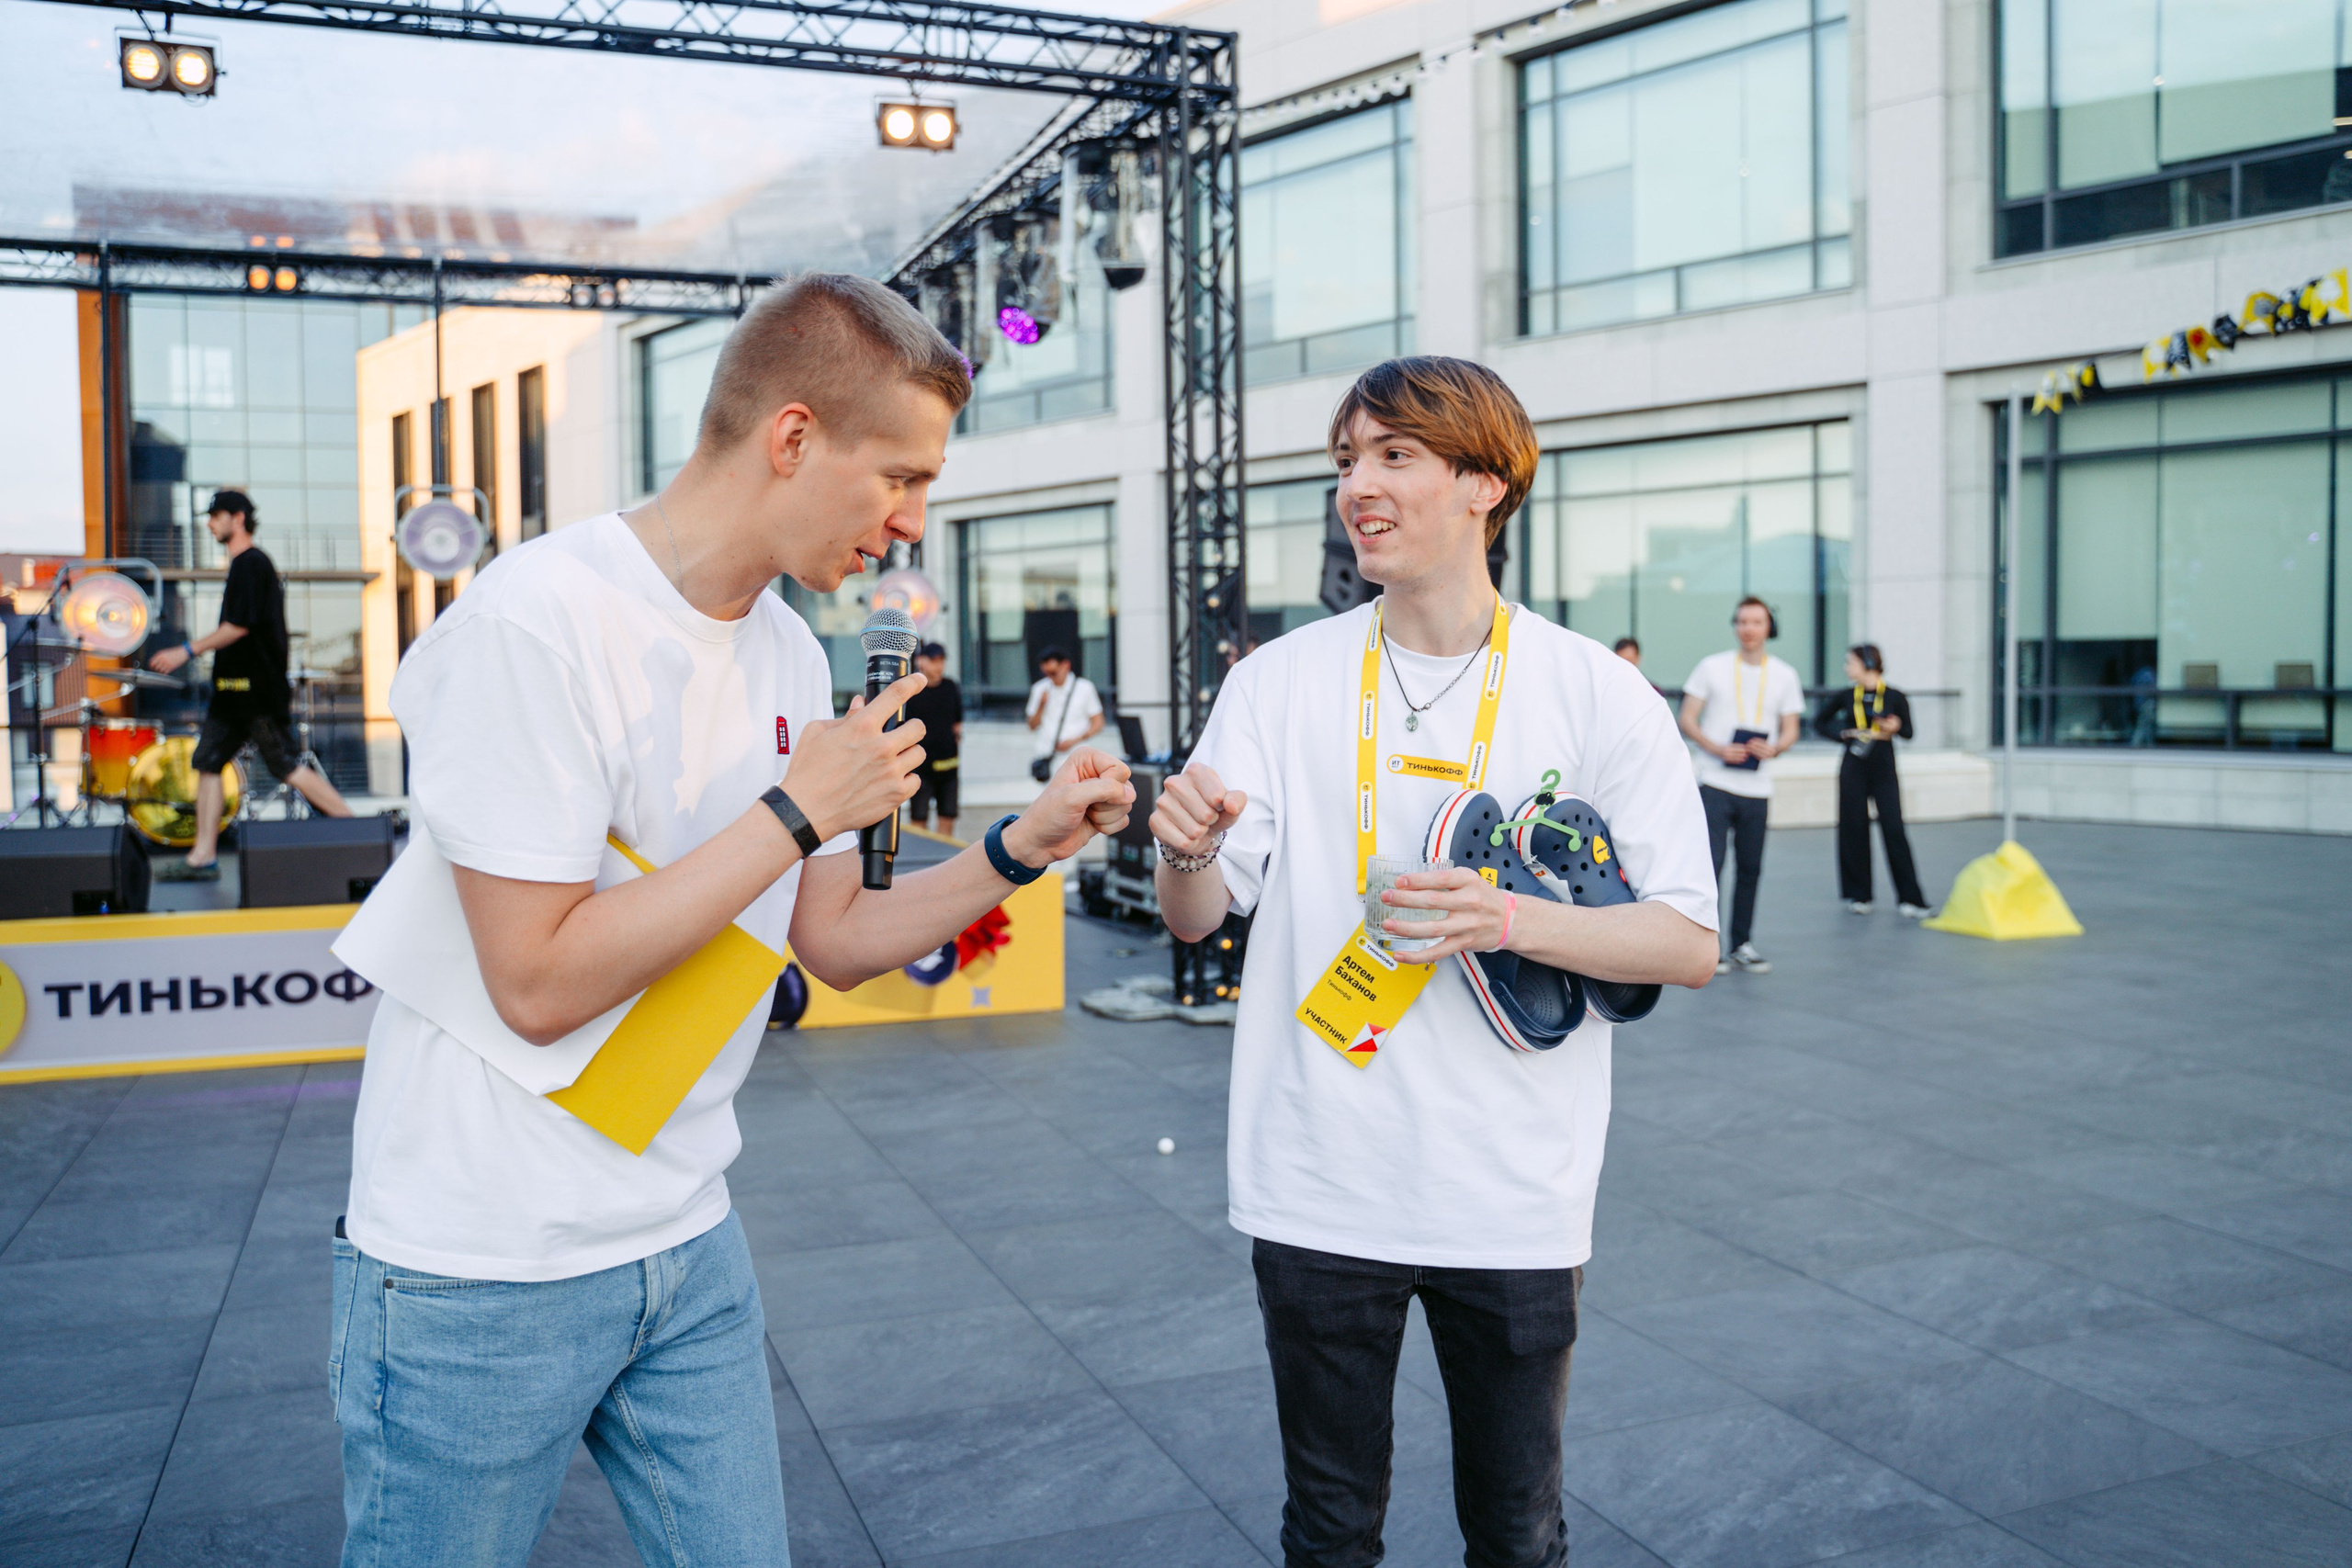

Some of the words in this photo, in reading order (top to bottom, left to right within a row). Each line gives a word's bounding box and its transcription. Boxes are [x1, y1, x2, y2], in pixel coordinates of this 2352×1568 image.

[1407, 761, 1464, 775] ТИНЬКОФФ
[1335, 965, 1377, 1001] Баханов
[1342, 955, 1375, 983] Артем
[1305, 1007, 1348, 1044] УЧАСТНИК
